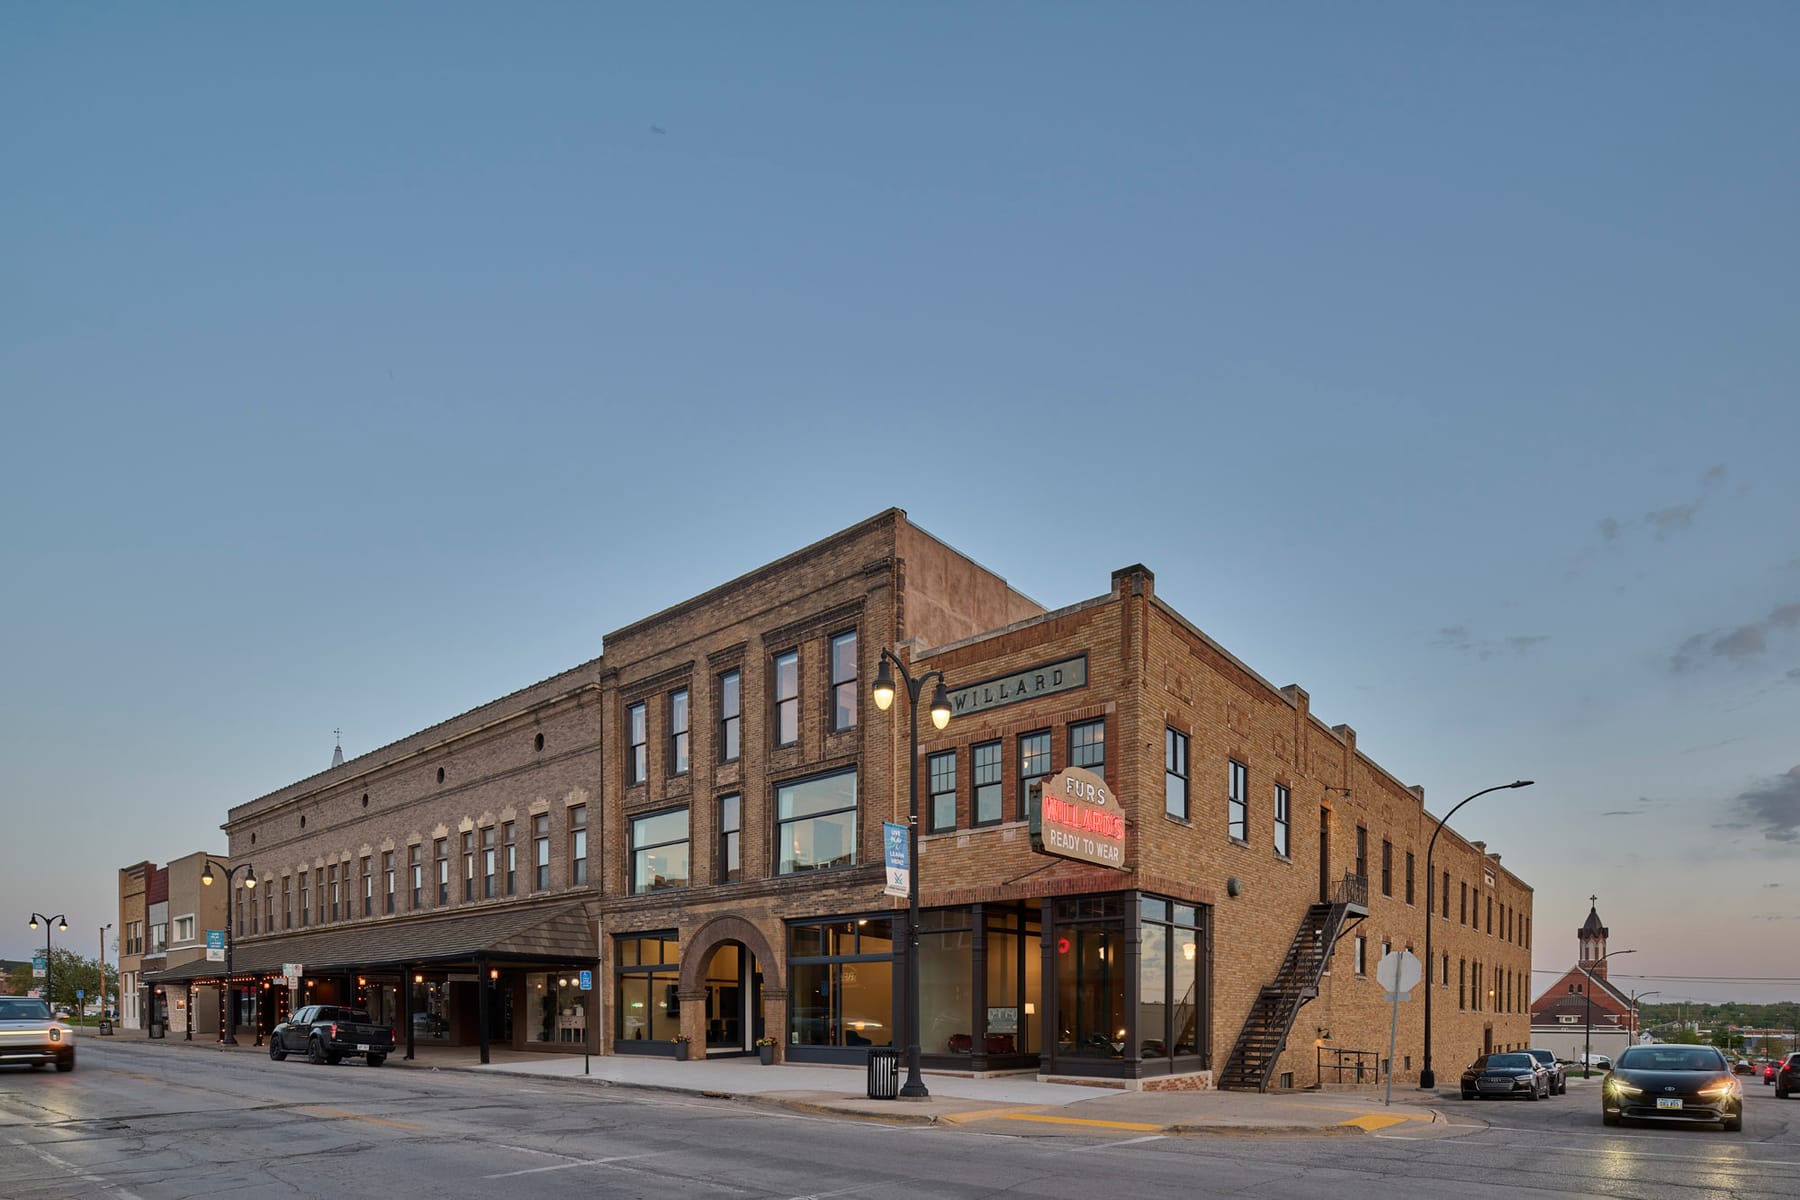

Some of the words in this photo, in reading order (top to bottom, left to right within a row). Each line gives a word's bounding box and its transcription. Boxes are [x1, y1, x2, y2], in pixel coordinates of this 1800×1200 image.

[954, 669, 1063, 711] WILLARD
[1065, 776, 1106, 805] FURS
[1044, 795, 1124, 841] WILLARD'S
[1050, 829, 1081, 852] READY
[1083, 838, 1095, 856] TO
[1096, 842, 1120, 861] WEAR
